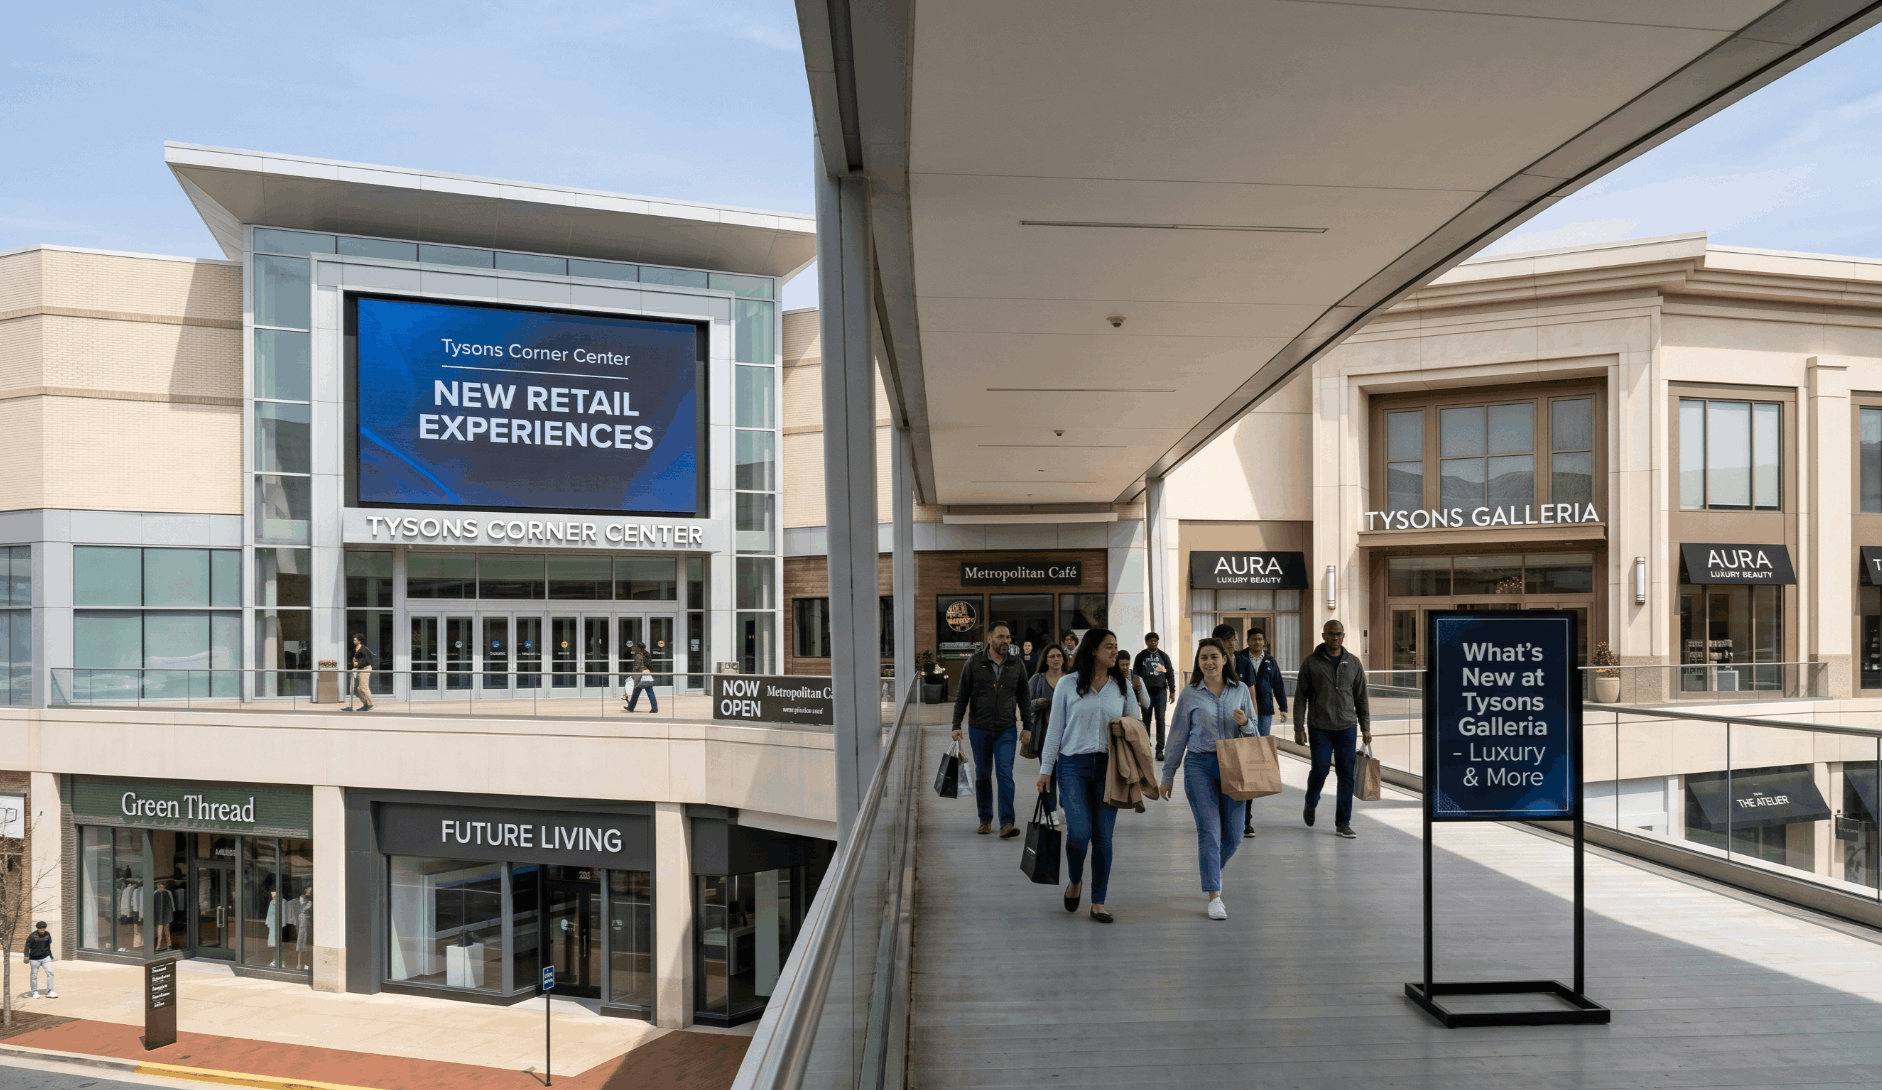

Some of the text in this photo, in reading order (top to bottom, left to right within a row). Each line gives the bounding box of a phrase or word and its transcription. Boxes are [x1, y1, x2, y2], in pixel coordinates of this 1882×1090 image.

[441, 338, 631, 366] Tysons Corner Center
[434, 379, 640, 417] NEW RETAIL
[419, 413, 654, 451] EXPERIENCES
[1364, 502, 1600, 531] TYSONS GALLERIA
[366, 515, 704, 545] TYSONS CORNER CENTER
[1214, 556, 1283, 575] AURA
[1707, 549, 1773, 569] AURA
[965, 566, 1077, 582] Metropolitan Café
[1216, 576, 1281, 584] LUXURY BEAUTY
[1710, 570, 1773, 579] LUXURY BEAUTY
[1462, 667, 1545, 687] New at
[722, 679, 761, 698] NOW
[766, 685, 822, 701] Metropolitan
[720, 699, 762, 718] OPEN
[1461, 691, 1545, 716] Tysons
[1458, 716, 1548, 736] Galleria
[1470, 742, 1546, 766] Luxury
[1462, 767, 1544, 787] & More
[121, 791, 256, 823] Green Thread
[1736, 798, 1756, 809] THE
[441, 819, 622, 853] FUTURE LIVING
